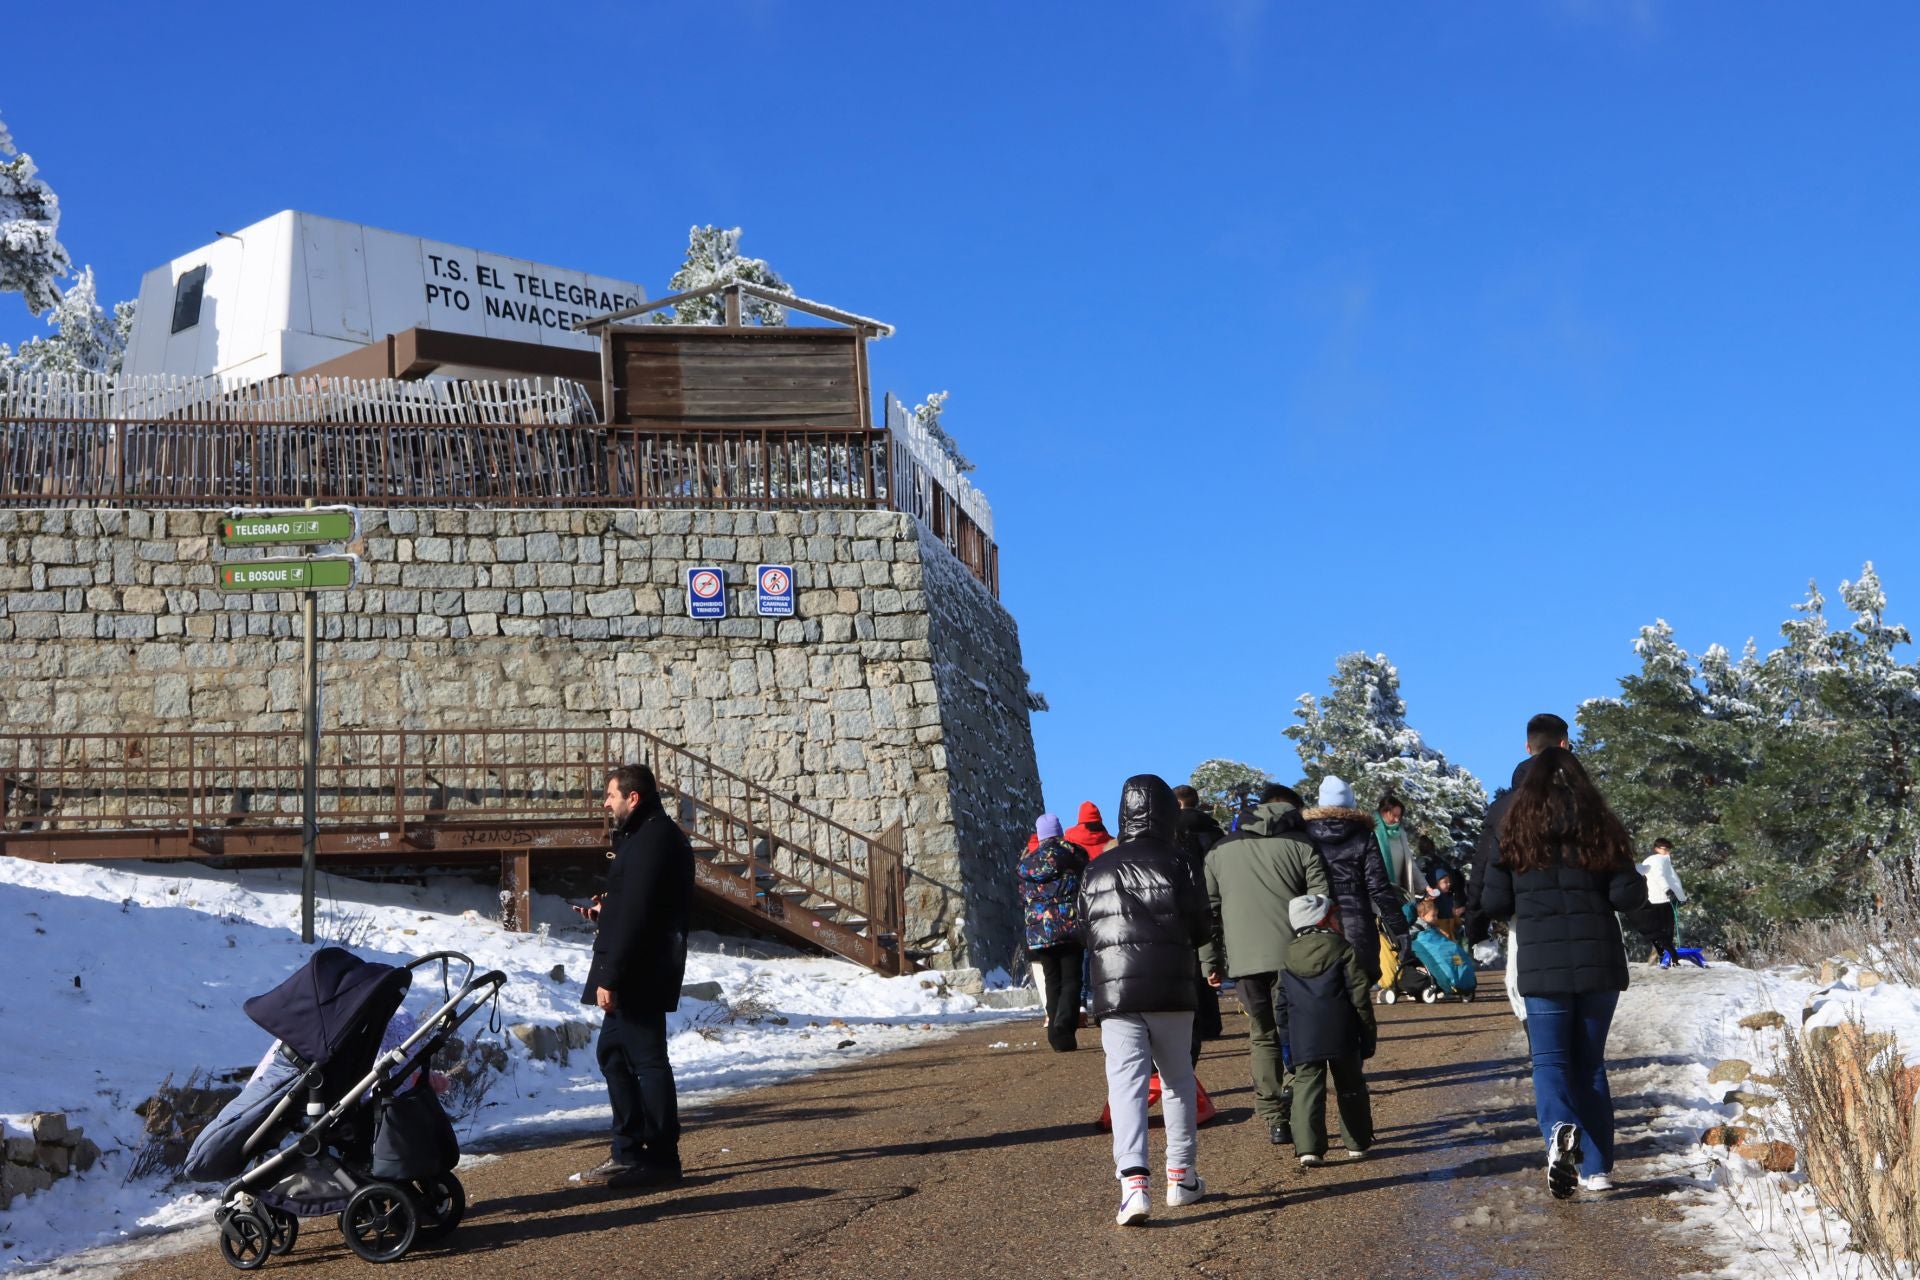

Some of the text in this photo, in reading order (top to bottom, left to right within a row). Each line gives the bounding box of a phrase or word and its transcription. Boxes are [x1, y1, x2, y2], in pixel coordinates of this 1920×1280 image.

[428, 255, 468, 282] T.S.
[476, 265, 505, 290] EL
[425, 284, 470, 311] PTO
[235, 523, 290, 536] TELEGRAFO
[234, 570, 287, 582] EL BOSQUE
